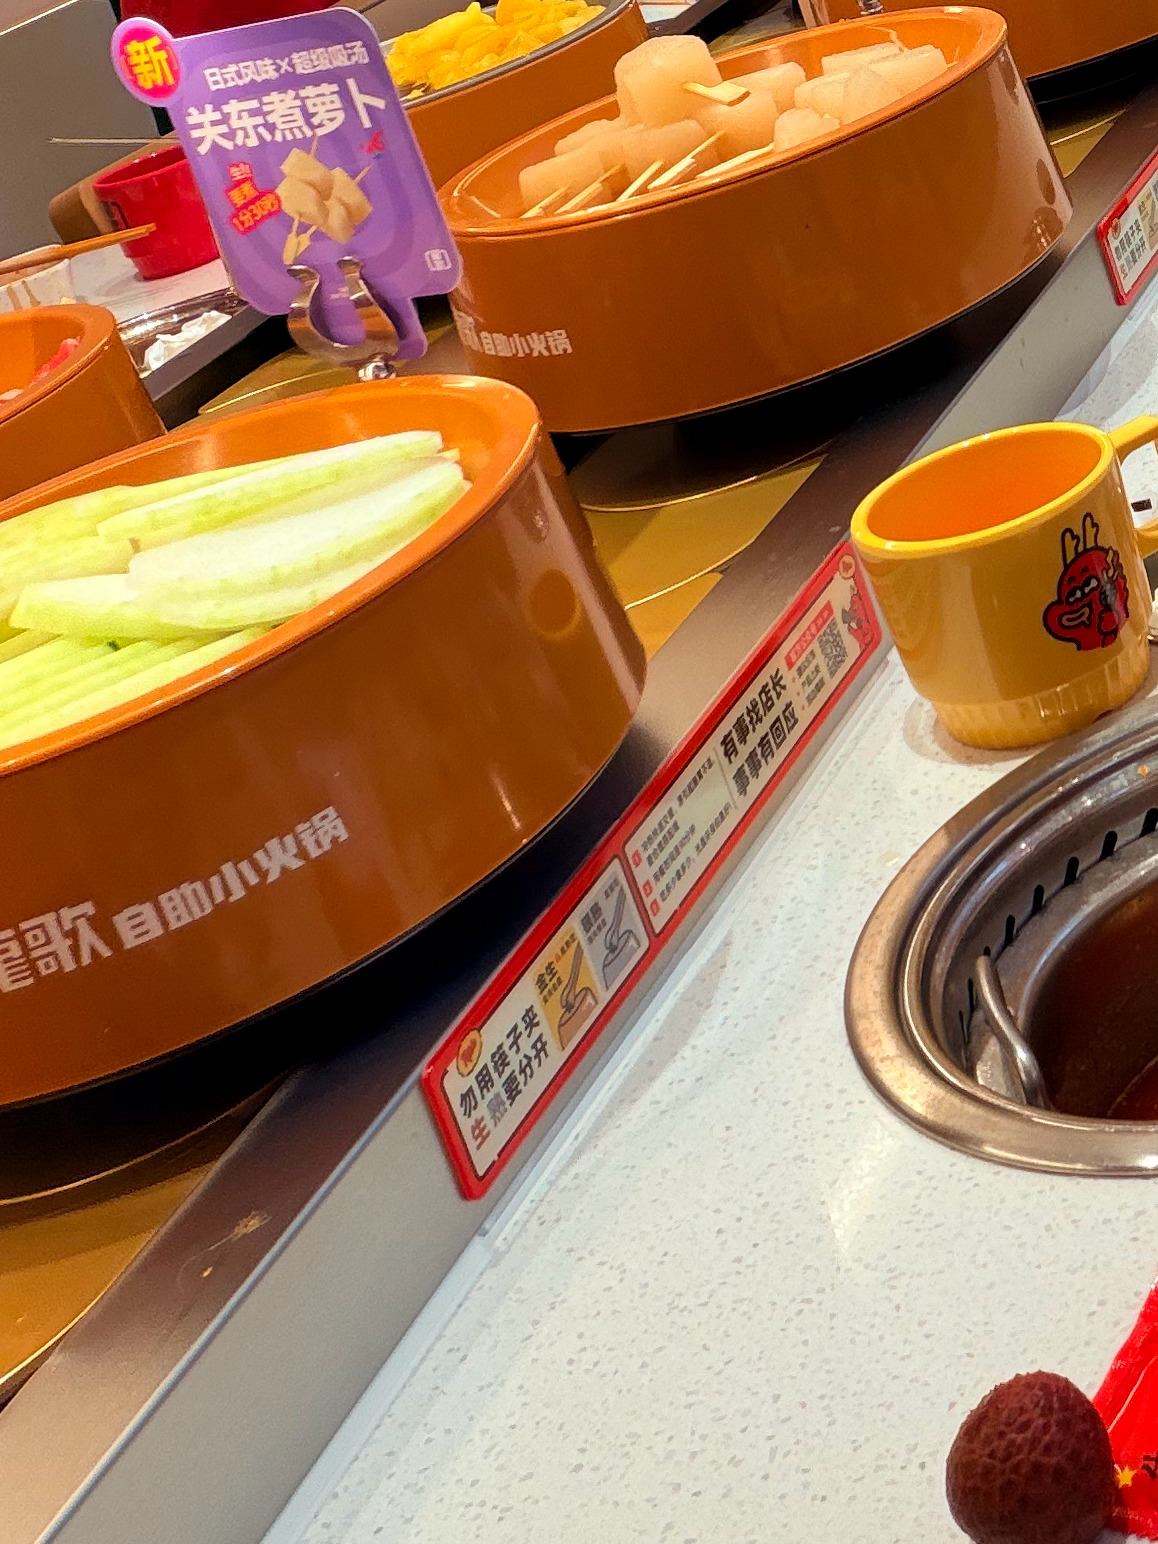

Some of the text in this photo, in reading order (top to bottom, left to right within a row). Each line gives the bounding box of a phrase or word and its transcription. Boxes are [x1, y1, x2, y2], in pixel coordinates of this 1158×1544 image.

[124, 36, 175, 90] 新
[186, 78, 386, 155] 关东煮萝卜
[721, 668, 787, 764] 有事找店长
[732, 704, 799, 798] 事事有回应
[112, 806, 349, 950] 自助小火锅
[460, 1005, 540, 1118] 勿用筷子夹
[471, 1033, 551, 1151] 生熟要分开
